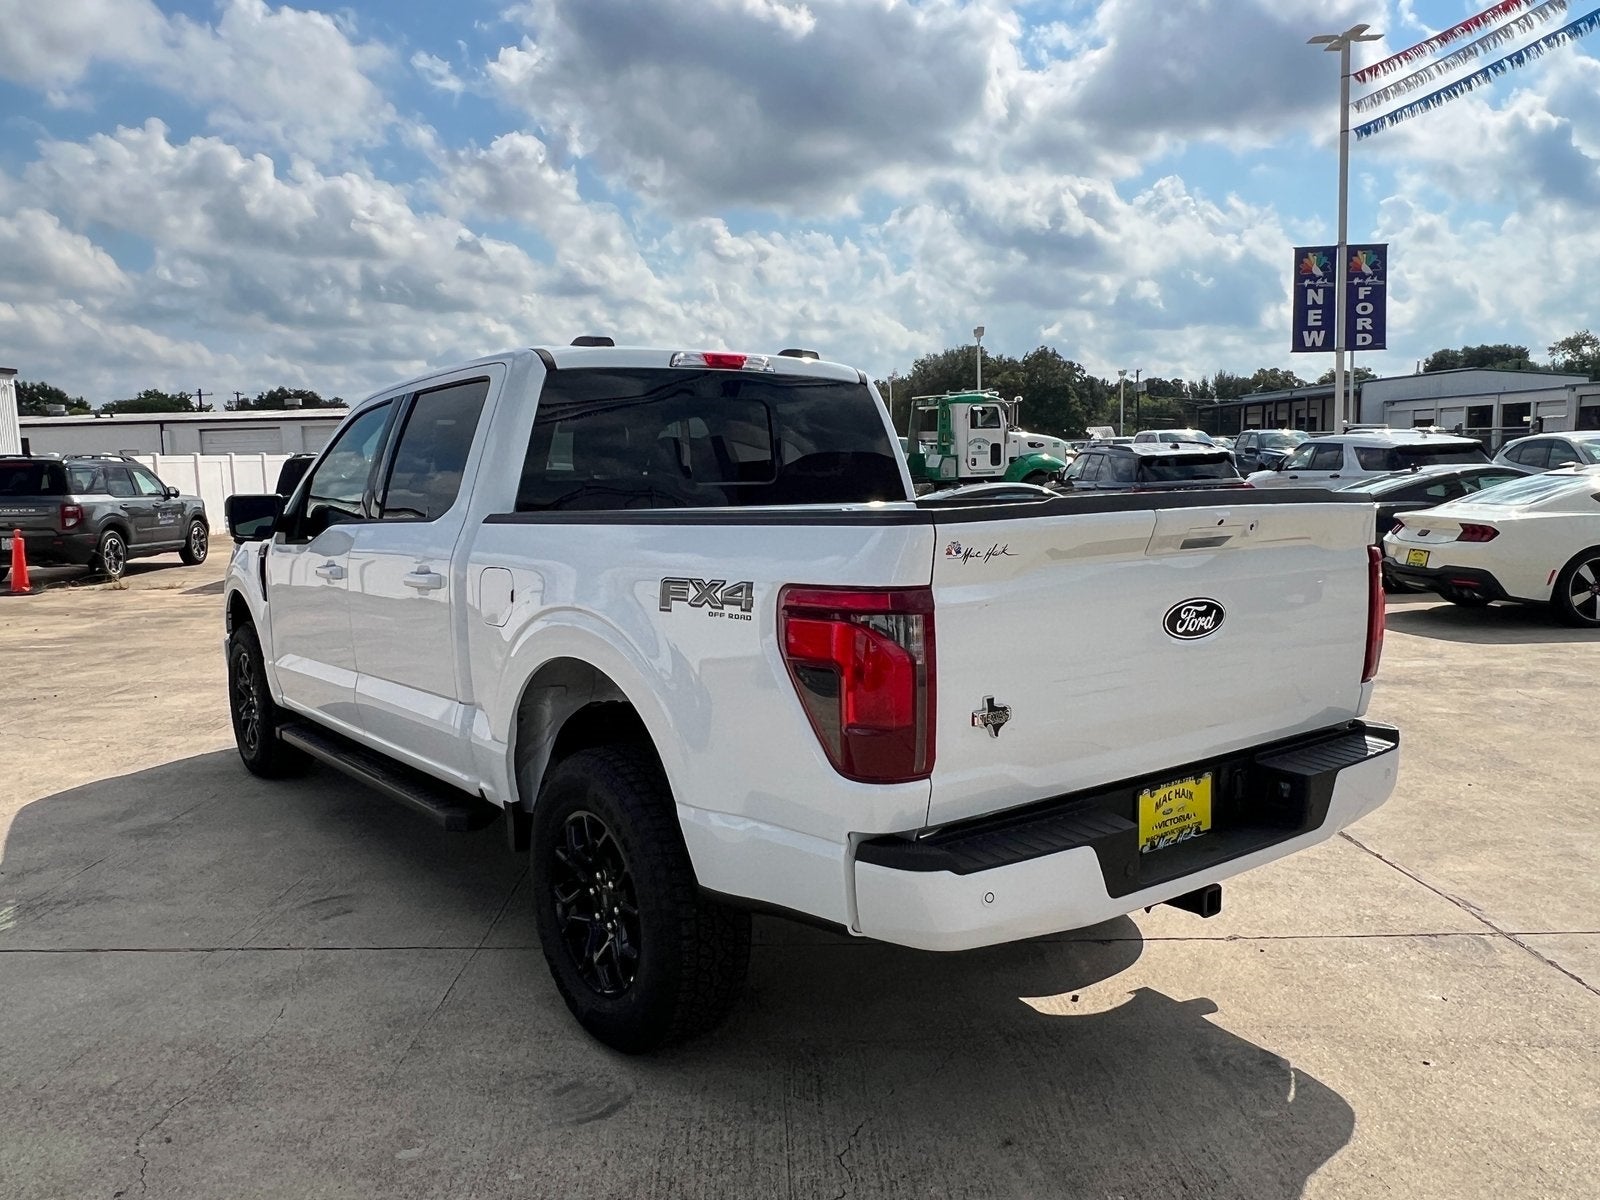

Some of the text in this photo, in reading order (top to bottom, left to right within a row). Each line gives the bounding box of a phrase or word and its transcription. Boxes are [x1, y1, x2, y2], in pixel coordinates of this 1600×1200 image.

[1303, 288, 1326, 347] NEW
[1355, 286, 1374, 346] FORD
[983, 543, 1017, 564] Haik
[659, 576, 754, 612] FX4
[728, 613, 752, 621] ROAD
[1176, 604, 1217, 633] Ford
[1154, 790, 1173, 813] MAC
[1174, 788, 1194, 802] HAIK
